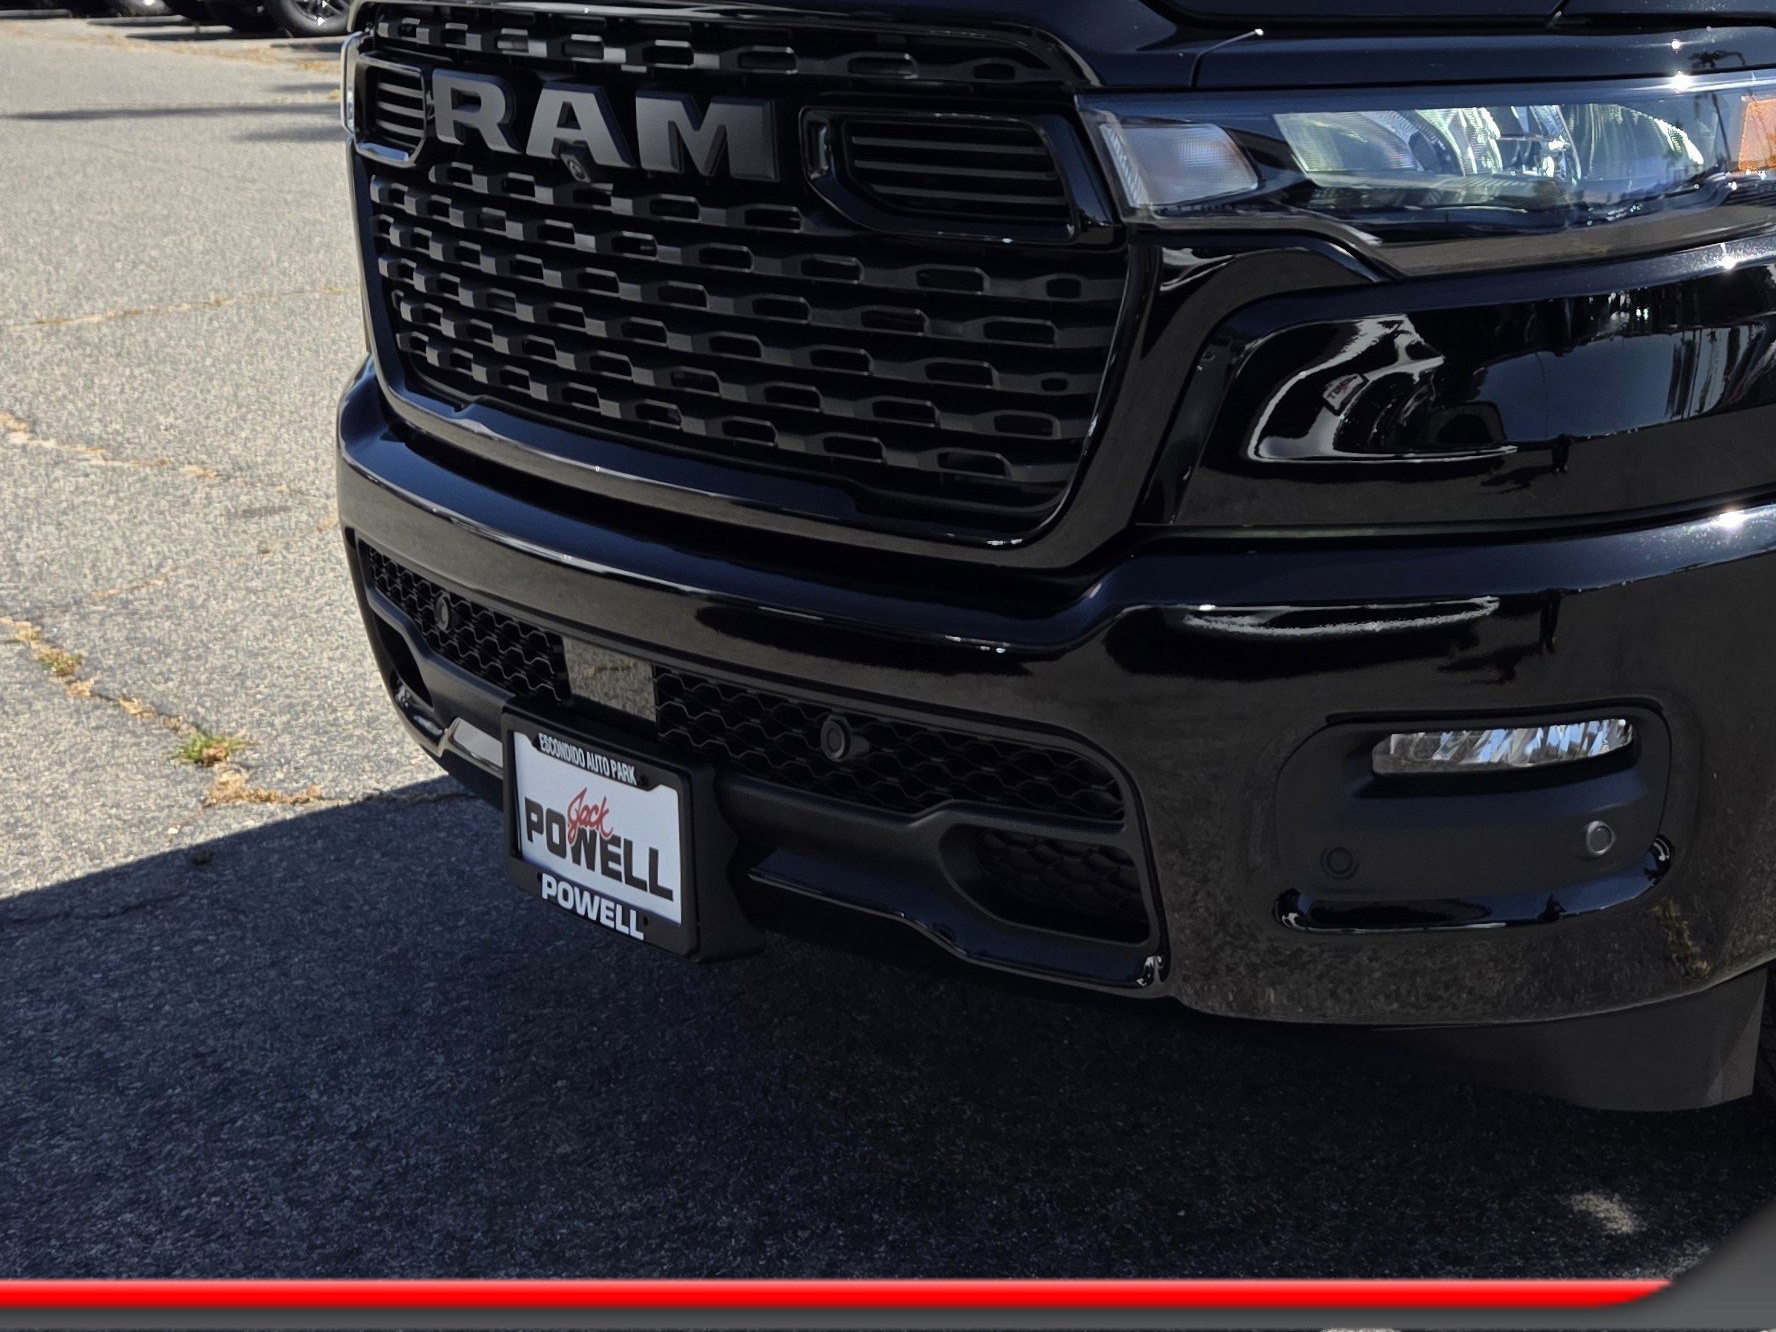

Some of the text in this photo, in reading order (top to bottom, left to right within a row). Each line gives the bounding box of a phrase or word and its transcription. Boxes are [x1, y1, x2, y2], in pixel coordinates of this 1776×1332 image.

[431, 68, 780, 183] RAM
[538, 732, 638, 786] ESCONDIDO AUTO PARK
[524, 796, 675, 903] POWELL
[567, 787, 614, 845] Jack
[541, 872, 645, 941] POWELL
